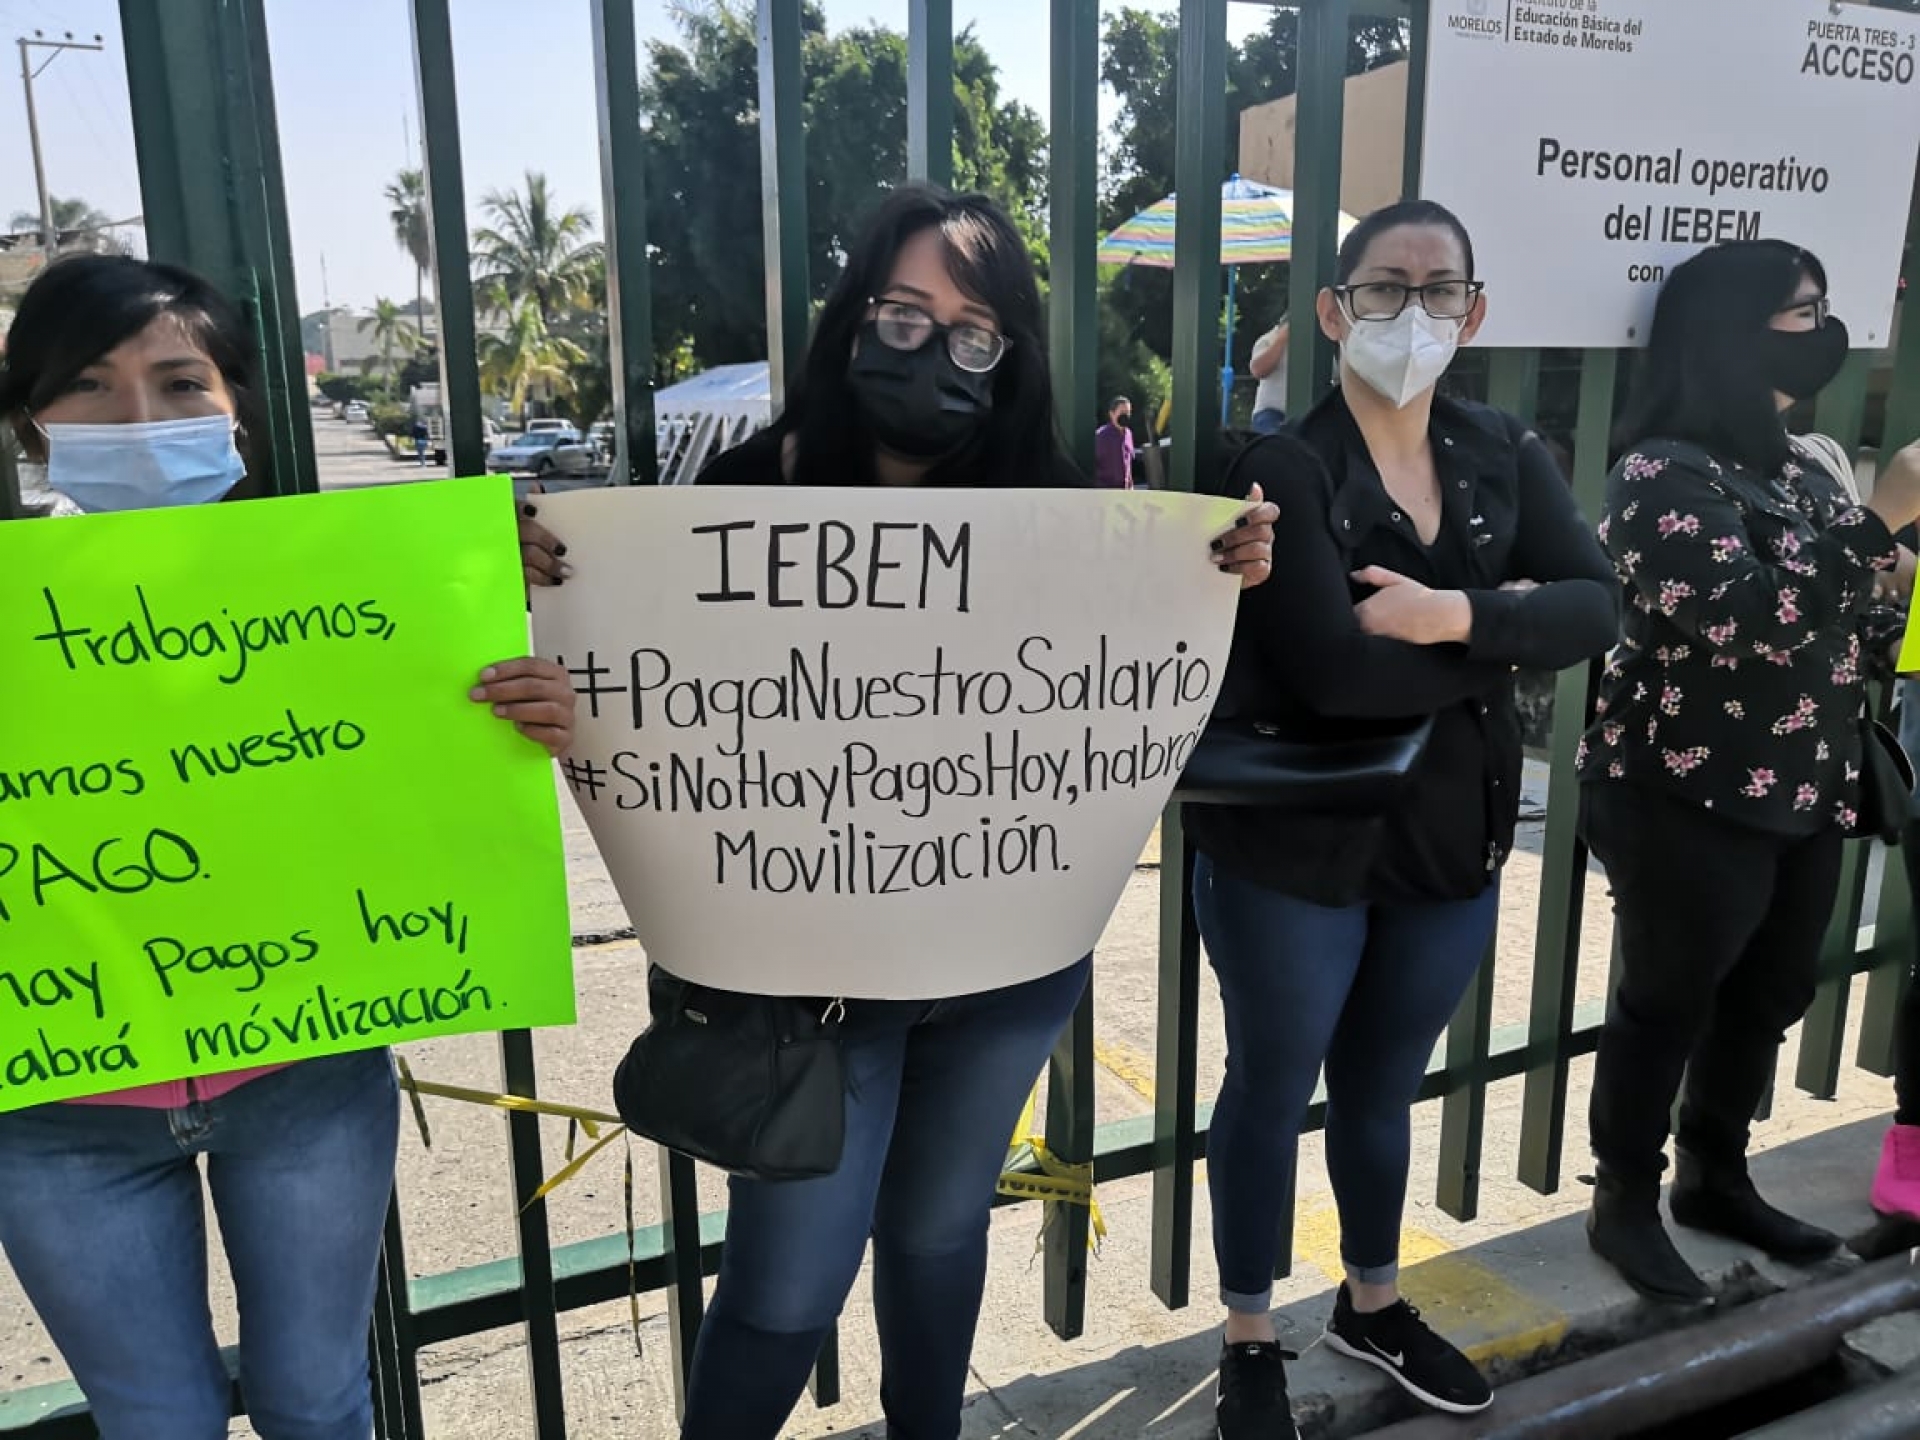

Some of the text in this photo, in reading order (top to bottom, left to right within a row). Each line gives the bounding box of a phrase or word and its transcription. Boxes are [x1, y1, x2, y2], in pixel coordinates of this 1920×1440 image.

[1448, 14, 1503, 34] MORELOS
[1514, 26, 1560, 46] Estado
[1562, 30, 1578, 47] de
[1581, 32, 1633, 53] Morelos
[1515, 7, 1642, 36] Educación Básica del
[1807, 20, 1861, 43] PUERTA
[1864, 27, 1898, 48] TRES
[1908, 34, 1915, 50] 3
[1801, 42, 1914, 84] ACCESO
[1537, 137, 1829, 195] Personal operativo
[1604, 203, 1761, 244] del IEBEM
[1627, 264, 1664, 282] con
[692, 520, 972, 613] IEBEM
[34, 584, 396, 684] trabajamos,
[170, 709, 366, 783] nuestro
[715, 814, 1071, 896] Movilización.
[143, 929, 321, 998] Pagos
[357, 888, 468, 954] hoy,
